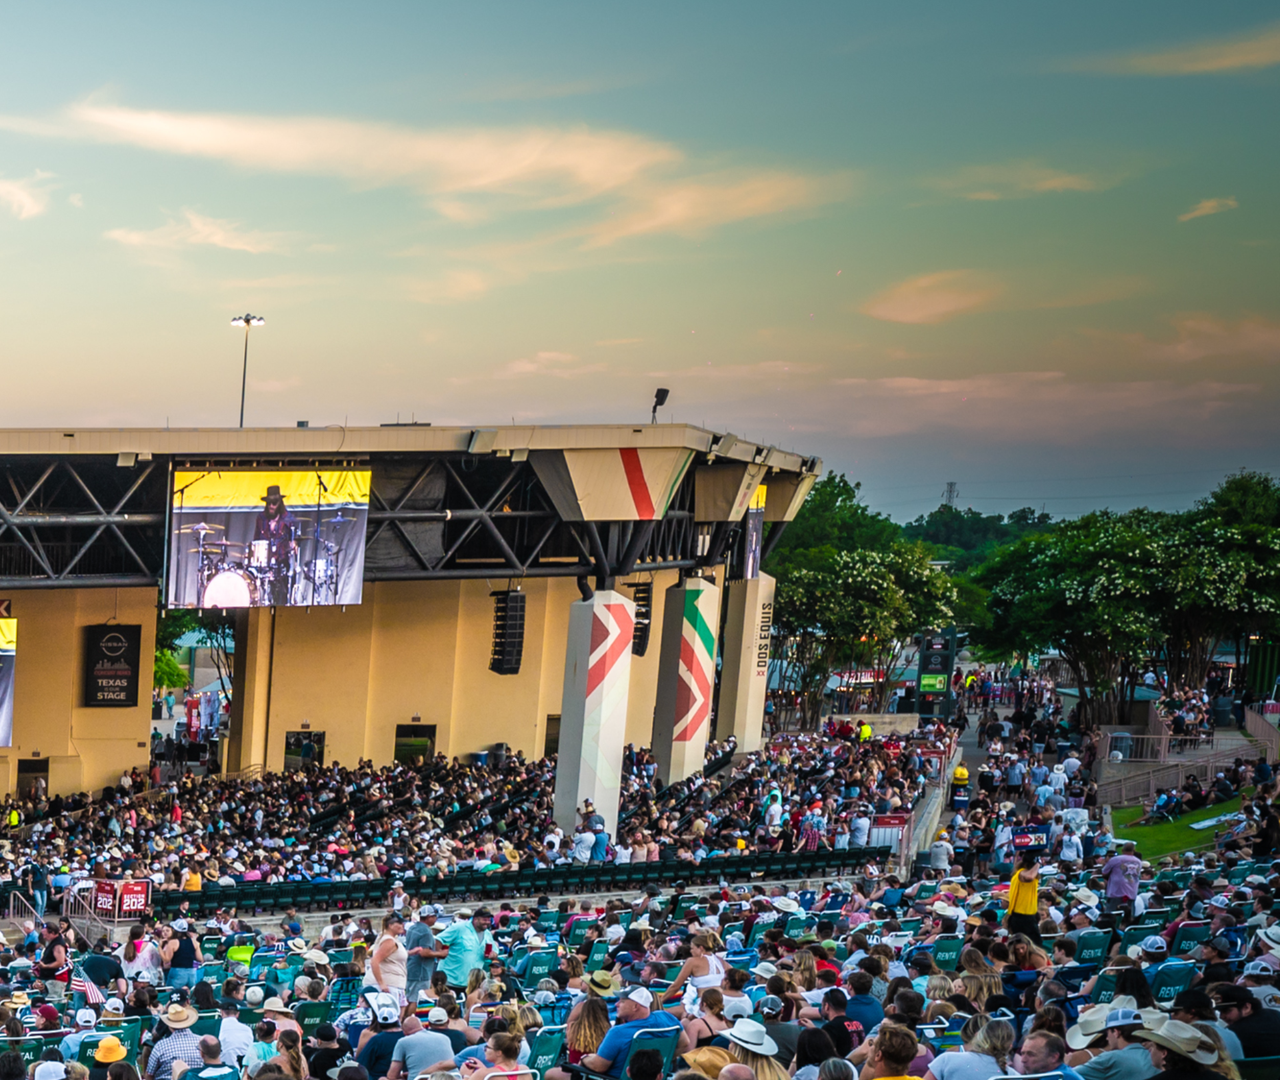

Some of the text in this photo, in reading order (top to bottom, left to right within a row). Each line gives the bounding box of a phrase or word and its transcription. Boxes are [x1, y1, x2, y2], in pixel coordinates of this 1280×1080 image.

[759, 603, 772, 640] EQUIS
[756, 643, 769, 668] DOS
[97, 679, 127, 687] TEXAS
[97, 692, 126, 700] STAGE
[97, 897, 113, 909] 202
[123, 899, 145, 910] 202
